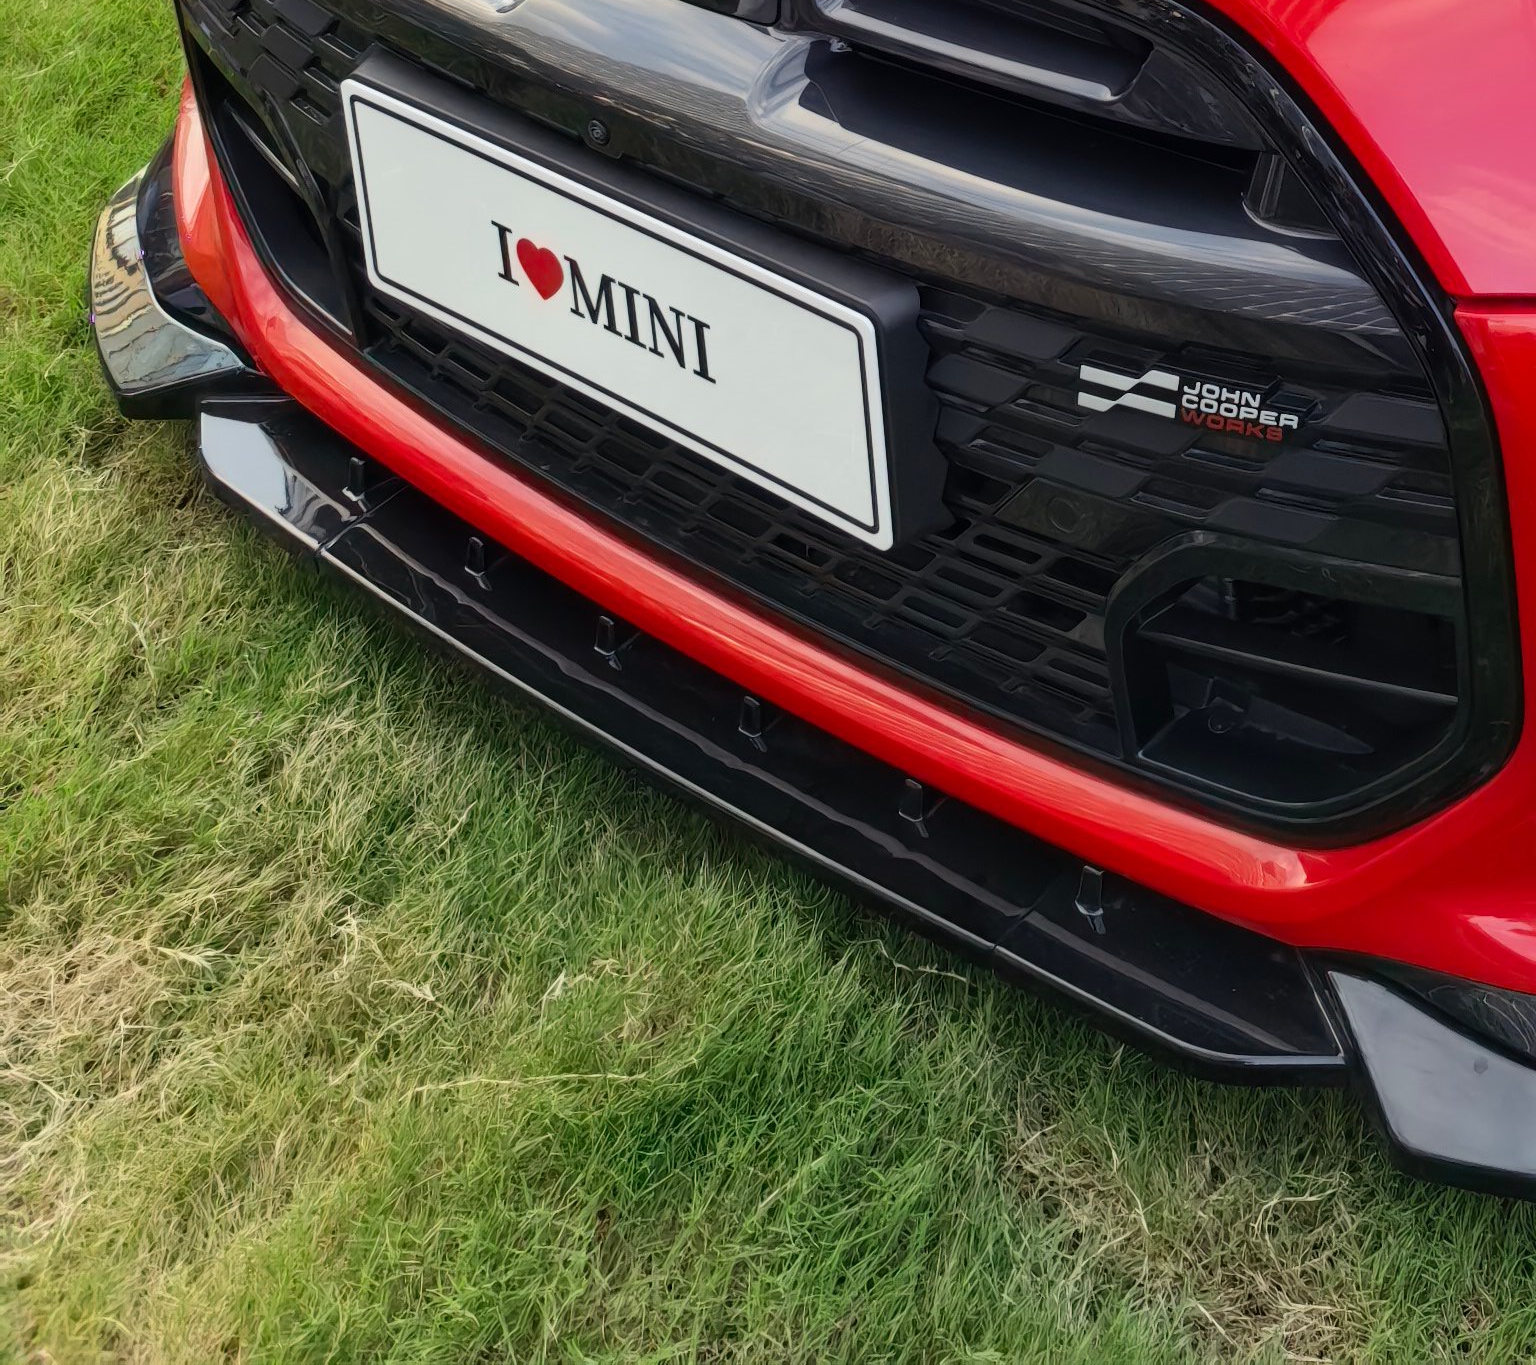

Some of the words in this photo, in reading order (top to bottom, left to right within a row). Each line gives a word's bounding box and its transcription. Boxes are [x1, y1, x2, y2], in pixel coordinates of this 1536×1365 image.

[491, 220, 520, 286] I
[563, 254, 717, 385] MINI
[1181, 394, 1299, 430] COOPER
[1183, 381, 1261, 408] JOHN
[1181, 407, 1284, 442] WORKS
